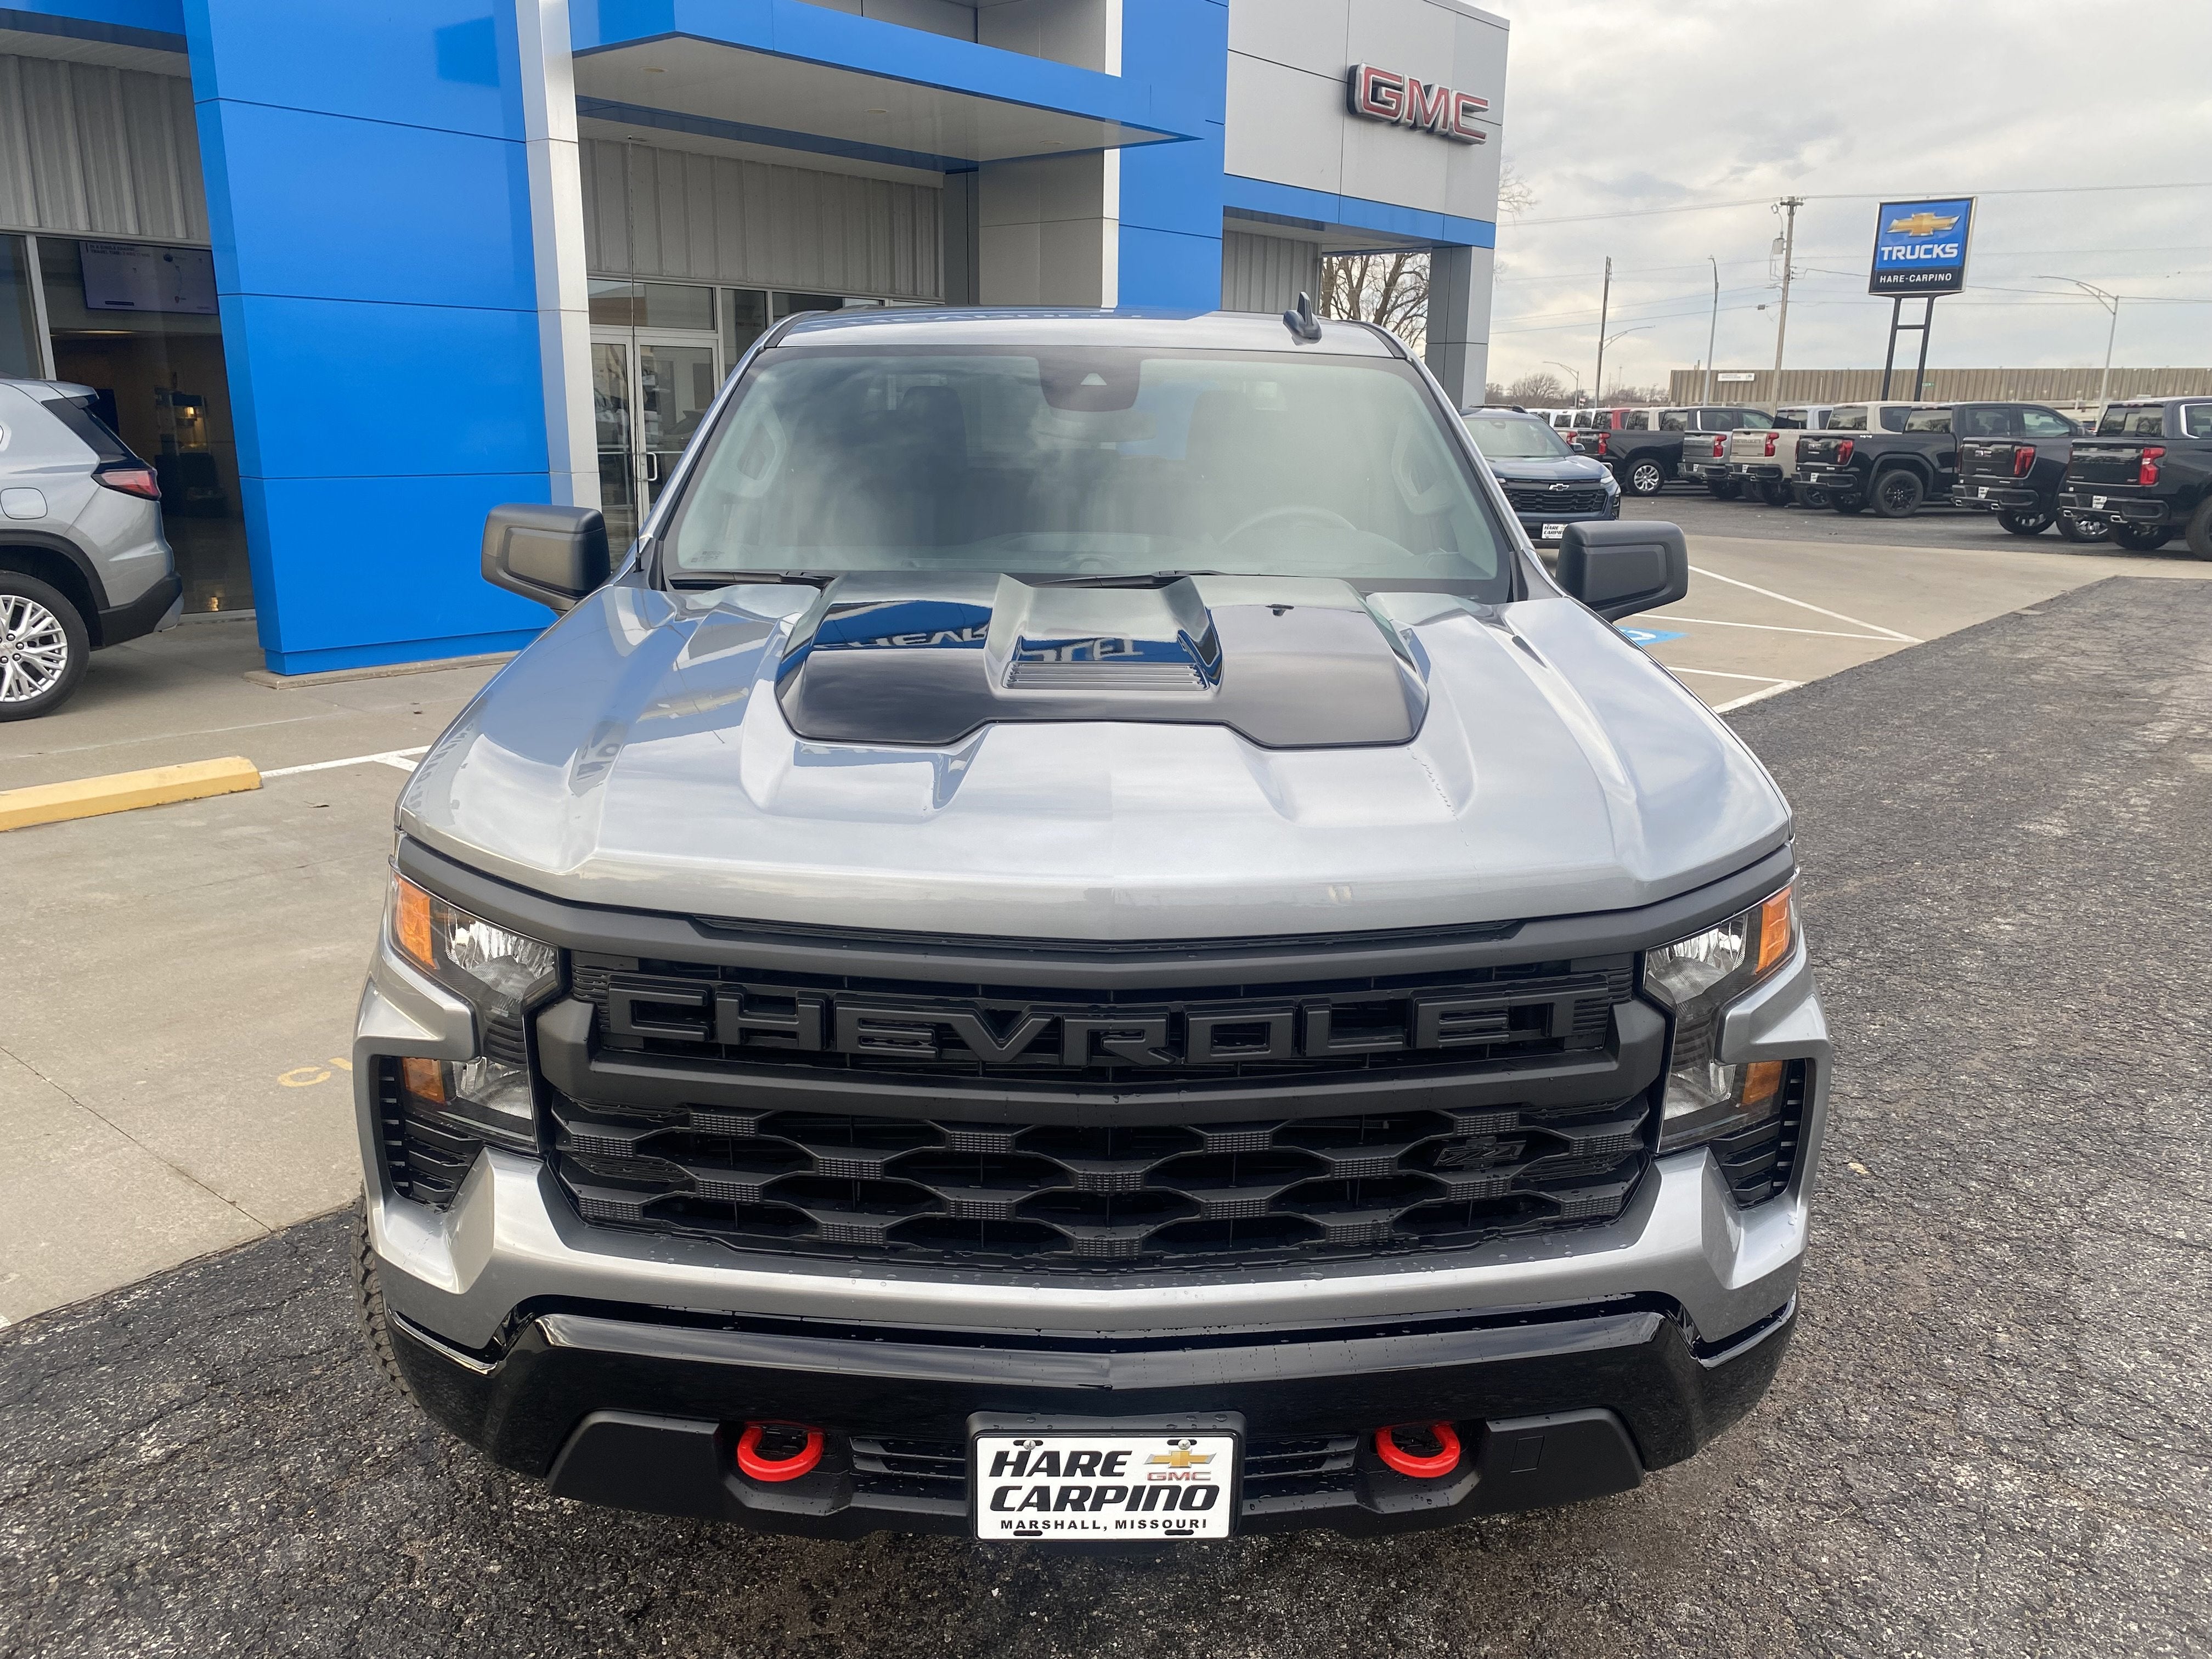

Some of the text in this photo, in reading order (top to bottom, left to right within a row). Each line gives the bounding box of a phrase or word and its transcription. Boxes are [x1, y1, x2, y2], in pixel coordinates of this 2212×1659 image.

[1348, 63, 1489, 144] GMC
[1881, 243, 1959, 261] TRUCKS
[1880, 273, 1952, 283] HARE-CARPINO
[608, 977, 1609, 1066] CHEVROLET
[989, 1450, 1132, 1477] HARE
[1146, 1470, 1212, 1481] GMC
[989, 1485, 1220, 1512] CARPINO
[1001, 1519, 1207, 1531] MARSHALL, MISSOURI
